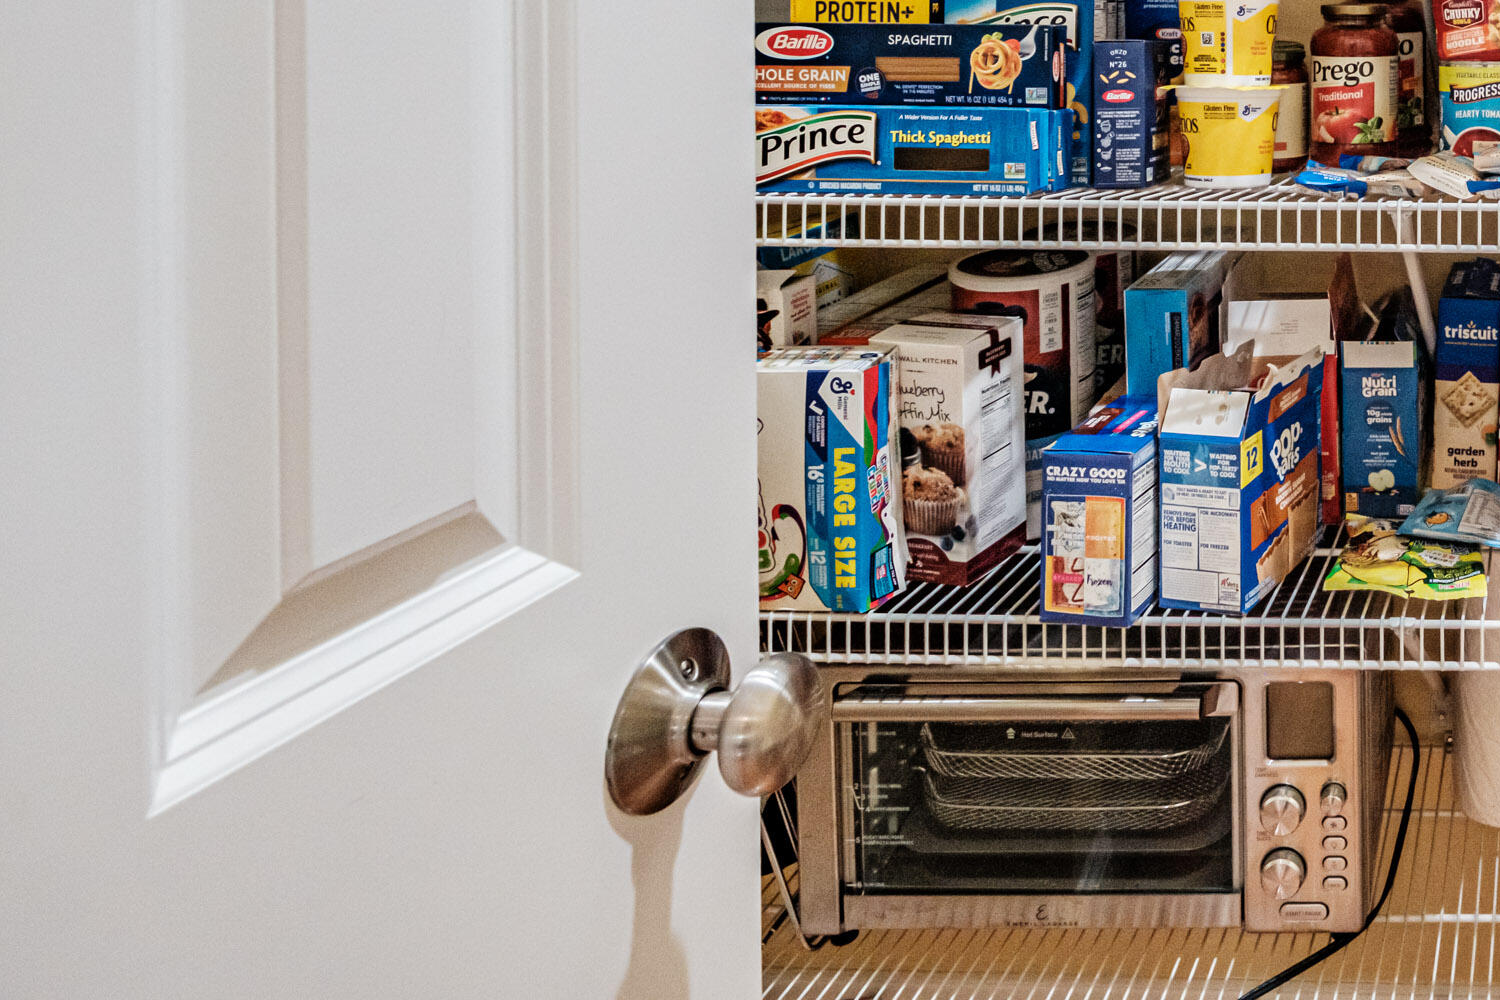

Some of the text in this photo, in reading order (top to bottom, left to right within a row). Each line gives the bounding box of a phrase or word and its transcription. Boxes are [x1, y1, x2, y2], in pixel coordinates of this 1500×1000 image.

[1444, 7, 1481, 20] CHUNKY
[888, 34, 952, 46] SPAGHETTI
[1161, 30, 1179, 38] Kraft
[773, 34, 828, 50] Barilla
[858, 73, 880, 81] ONE
[1312, 60, 1374, 87] Prego
[761, 122, 865, 167] Prince
[889, 129, 991, 148] Thick Spaghetti
[1444, 325, 1498, 340] triscuit
[1362, 375, 1396, 388] Nutri
[1362, 387, 1397, 397] Grain
[1163, 449, 1191, 457] WAITING
[1447, 446, 1485, 457] garden
[1453, 457, 1478, 467] herb
[1046, 466, 1126, 479] CRAZY GOOD
[834, 447, 856, 589] LARGE SIZE
[1163, 522, 1196, 532] HEATING
